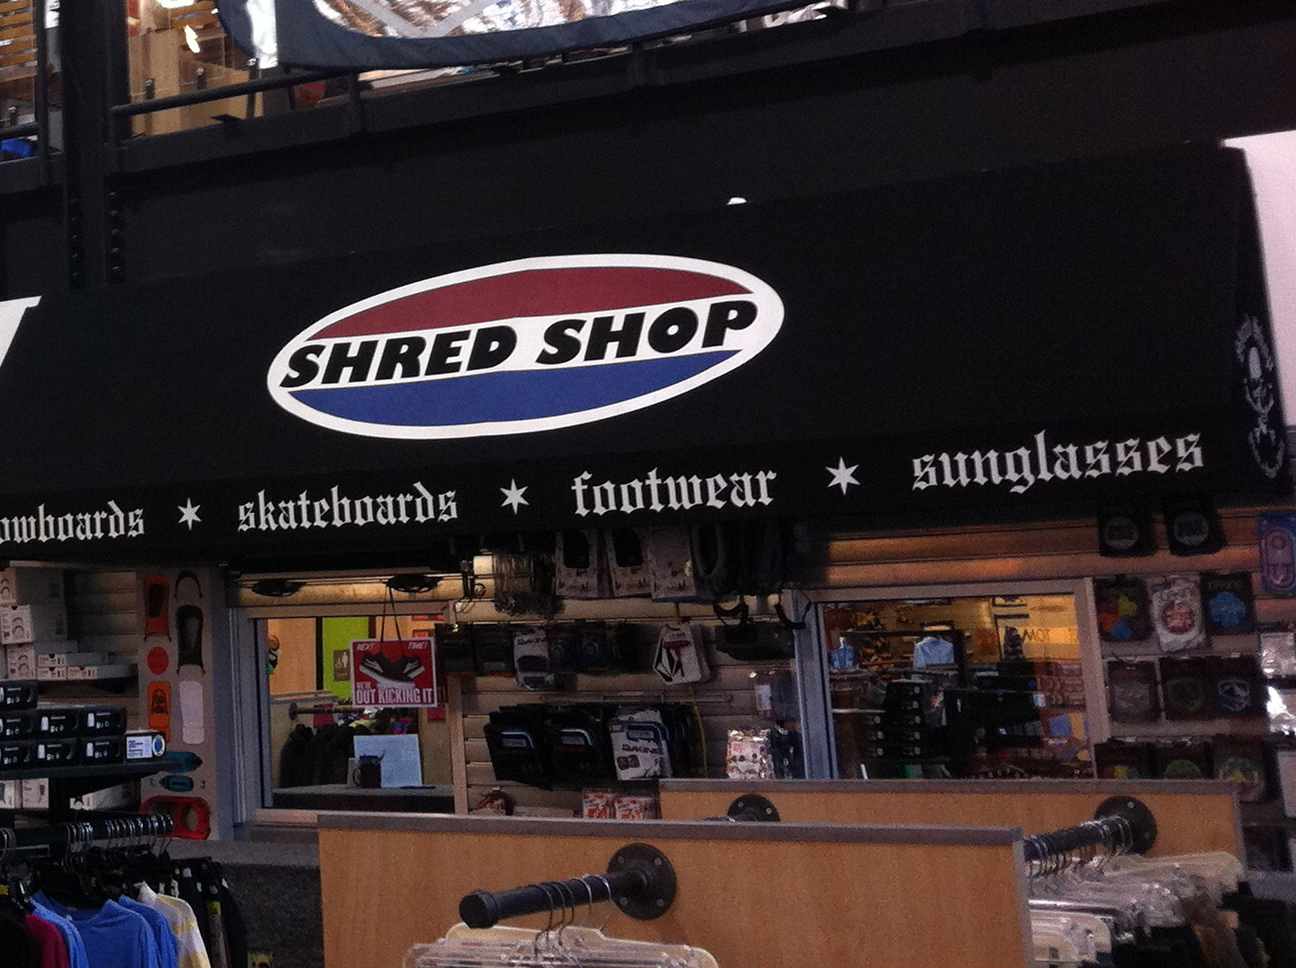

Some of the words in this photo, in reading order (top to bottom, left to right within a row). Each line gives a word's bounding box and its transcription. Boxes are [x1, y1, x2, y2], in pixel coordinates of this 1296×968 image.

[279, 325, 518, 389] SHRED
[535, 300, 759, 365] SHOP
[237, 481, 458, 532] skateboards
[570, 465, 778, 518] footwear
[911, 429, 1205, 494] sunglasses
[356, 688, 376, 704] OUT
[378, 688, 421, 704] KICKING
[422, 688, 433, 704] IT
